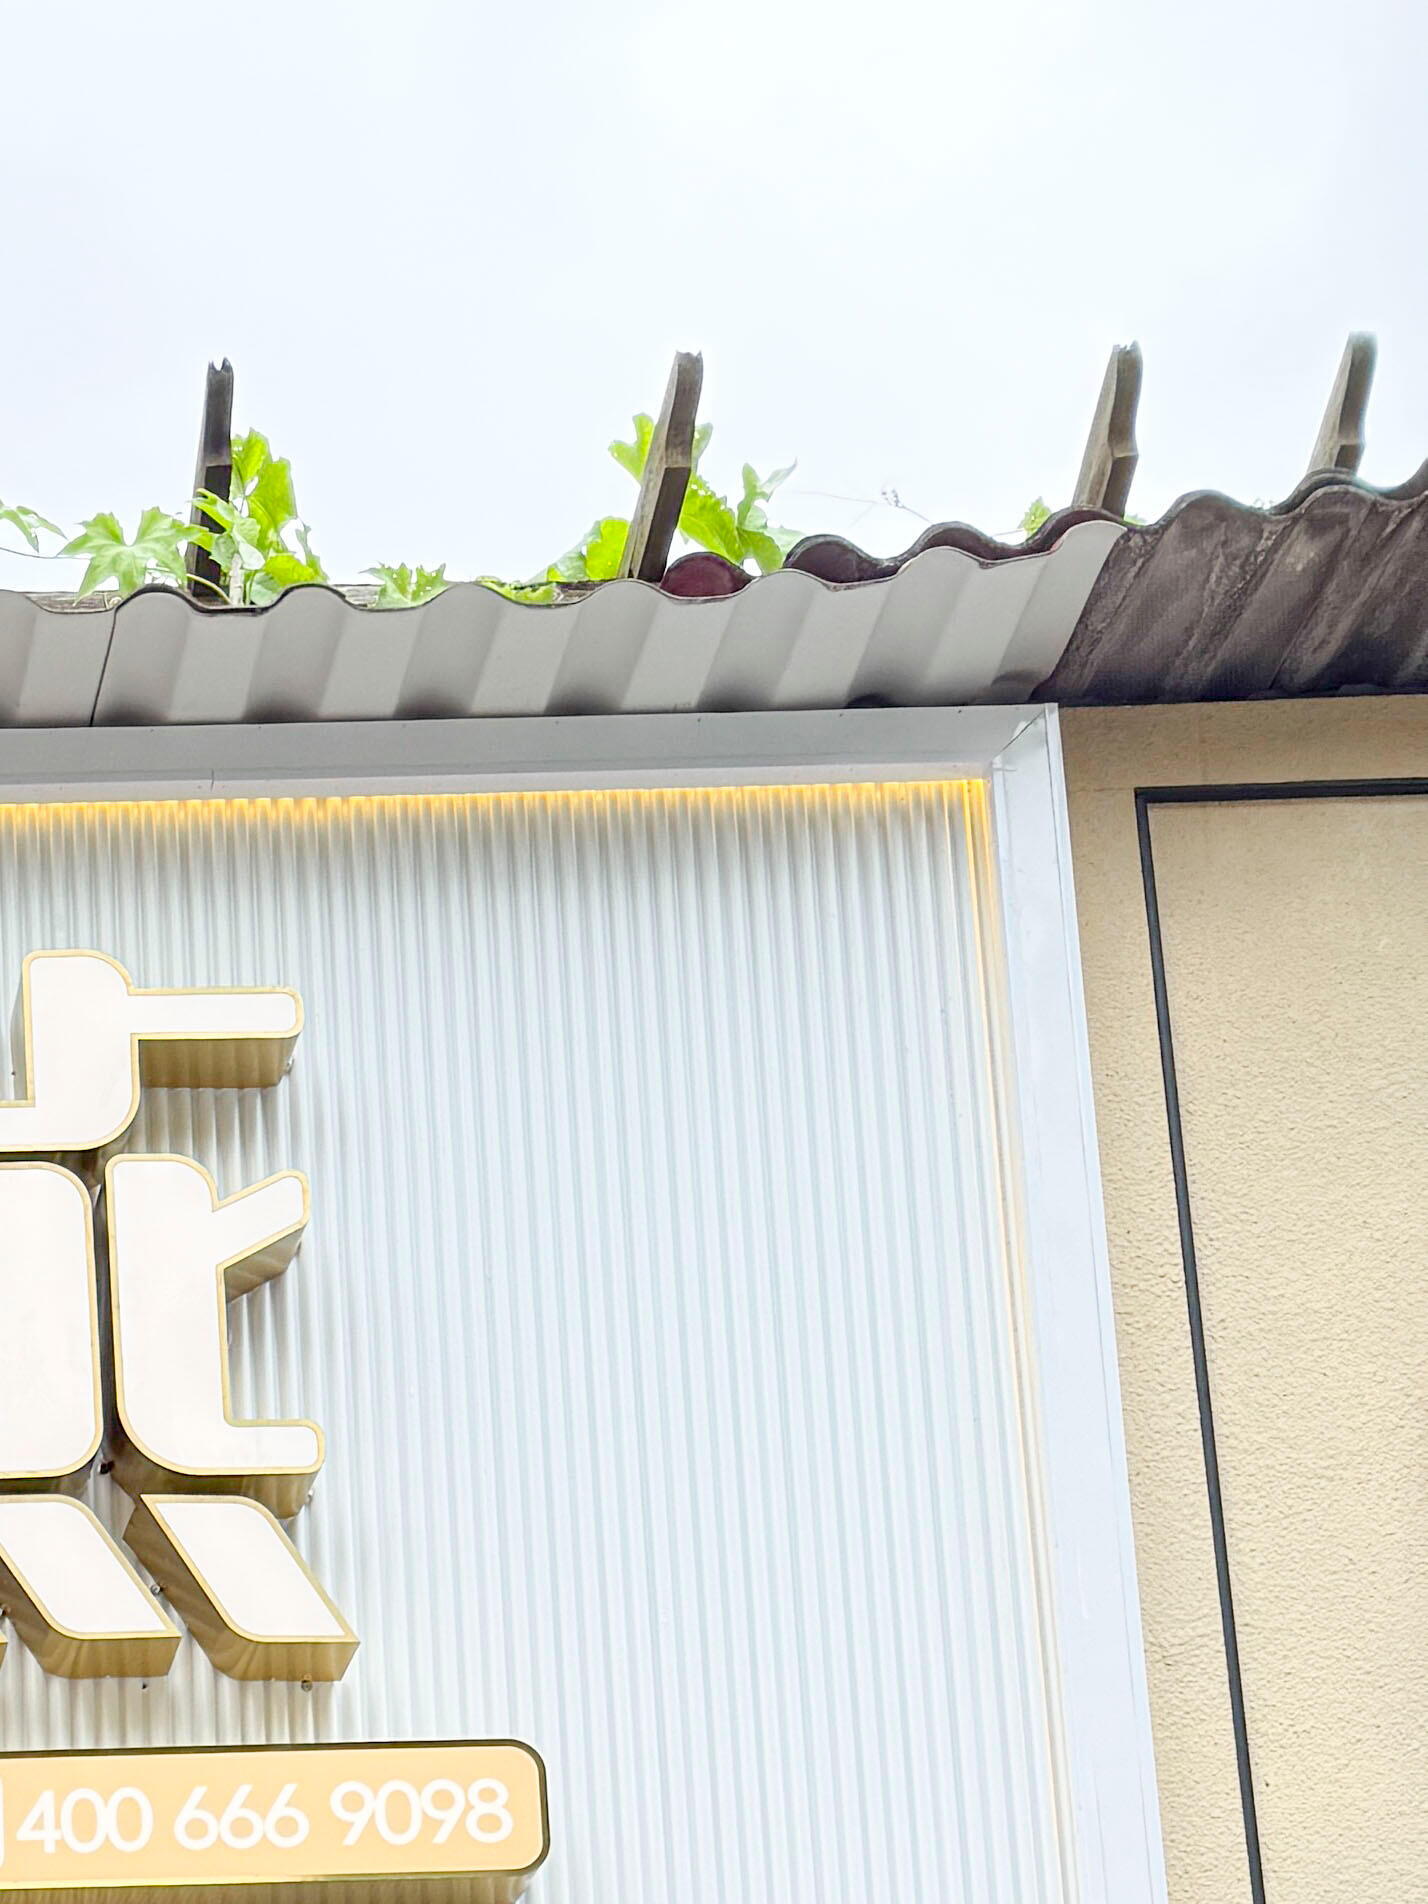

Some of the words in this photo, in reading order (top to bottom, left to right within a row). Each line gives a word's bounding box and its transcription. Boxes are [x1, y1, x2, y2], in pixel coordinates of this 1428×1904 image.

[15, 1785, 154, 1855] 400
[174, 1781, 310, 1851] 666
[330, 1777, 515, 1847] 9098
